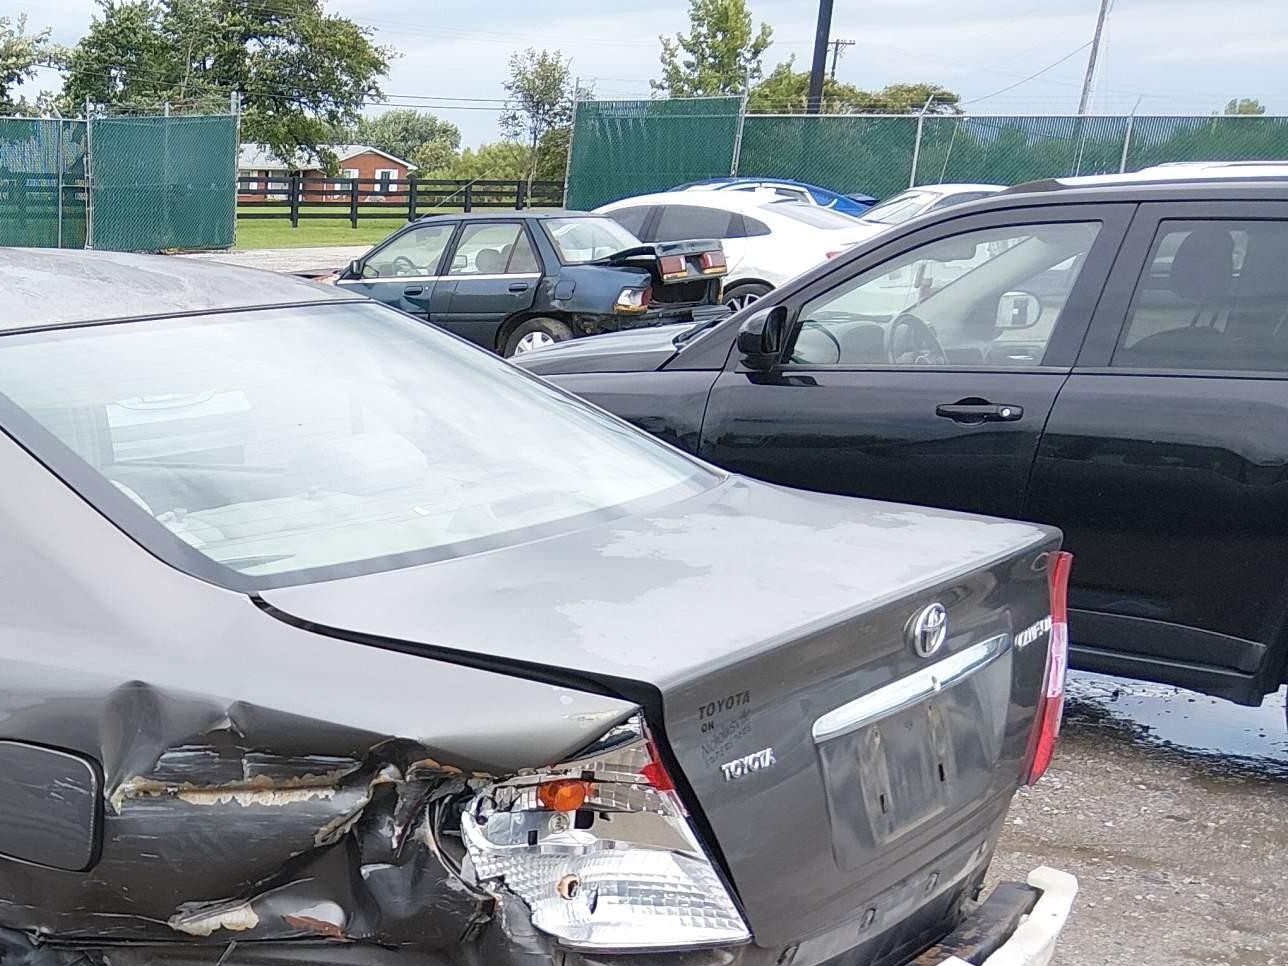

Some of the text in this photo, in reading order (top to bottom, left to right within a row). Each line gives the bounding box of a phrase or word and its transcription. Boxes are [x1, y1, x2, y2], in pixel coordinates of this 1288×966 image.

[698, 690, 751, 720] TOYOTA
[701, 720, 715, 733] ON
[720, 748, 777, 782] TOYOTA
